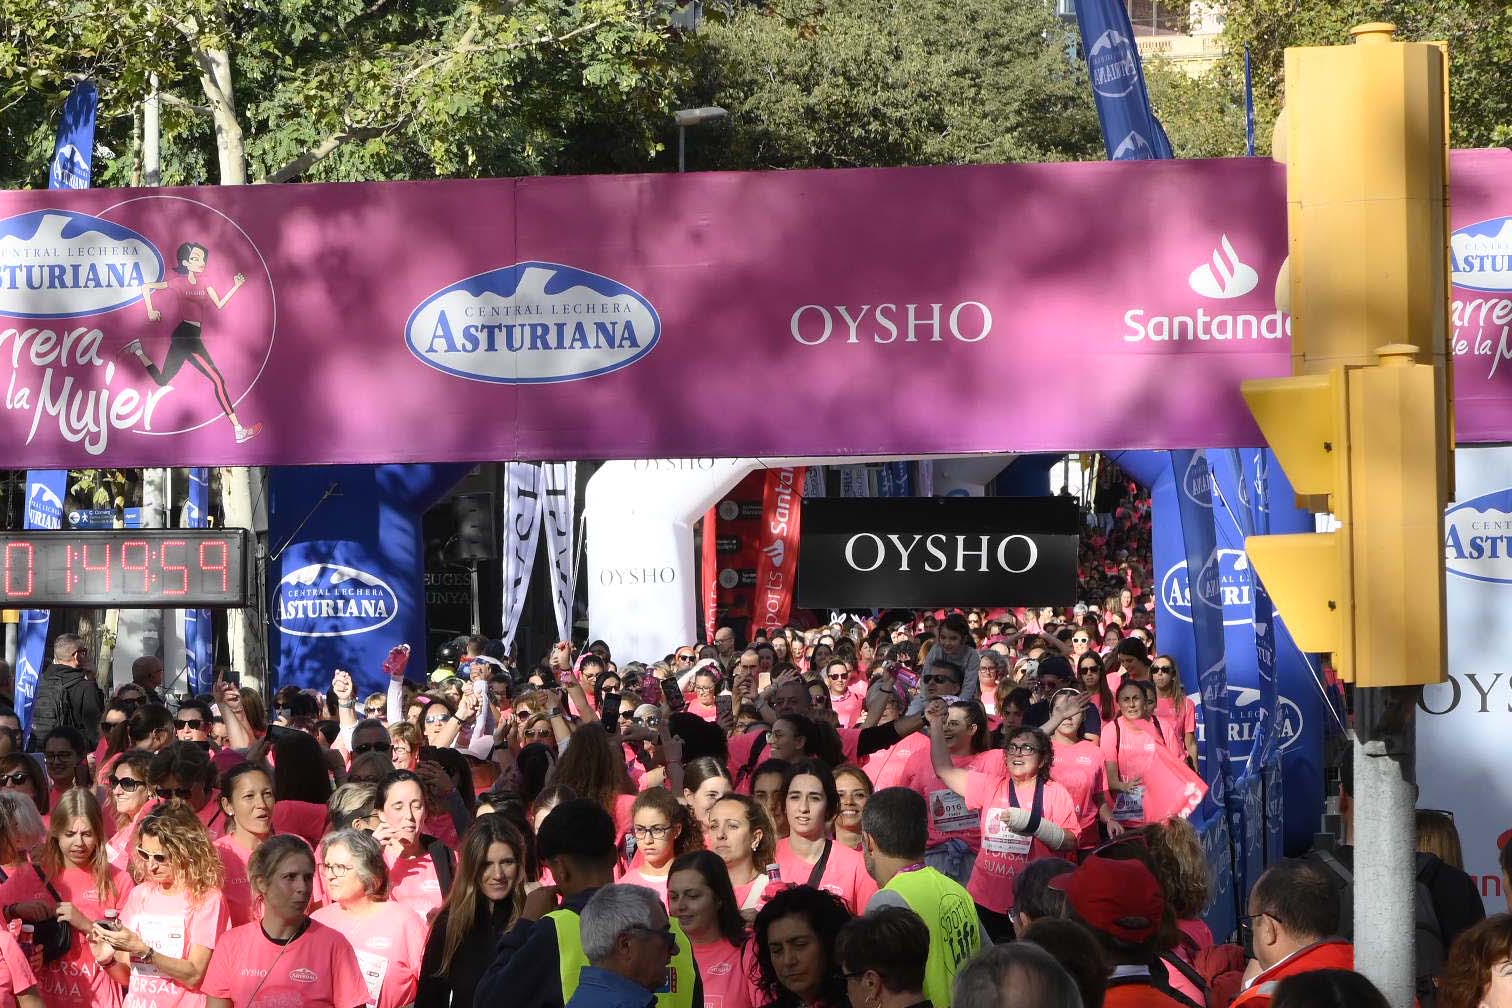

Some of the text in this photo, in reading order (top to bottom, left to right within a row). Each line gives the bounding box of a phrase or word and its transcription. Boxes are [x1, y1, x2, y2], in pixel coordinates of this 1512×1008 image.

[67, 245, 140, 257] LECHERA
[465, 302, 632, 318] CENTRAL LECHERA
[789, 301, 993, 345] OYSHO
[424, 309, 641, 354] ASTURIANA
[6, 367, 30, 411] la
[24, 360, 175, 456] Mujer
[4, 539, 230, 597] 01:49:59
[844, 532, 1039, 574] OYSHO
[288, 586, 384, 598] CENTRAL LECHERA
[599, 566, 676, 587] OYSHO
[275, 597, 388, 619] ASTURIANA
[1417, 674, 1512, 717] OY
